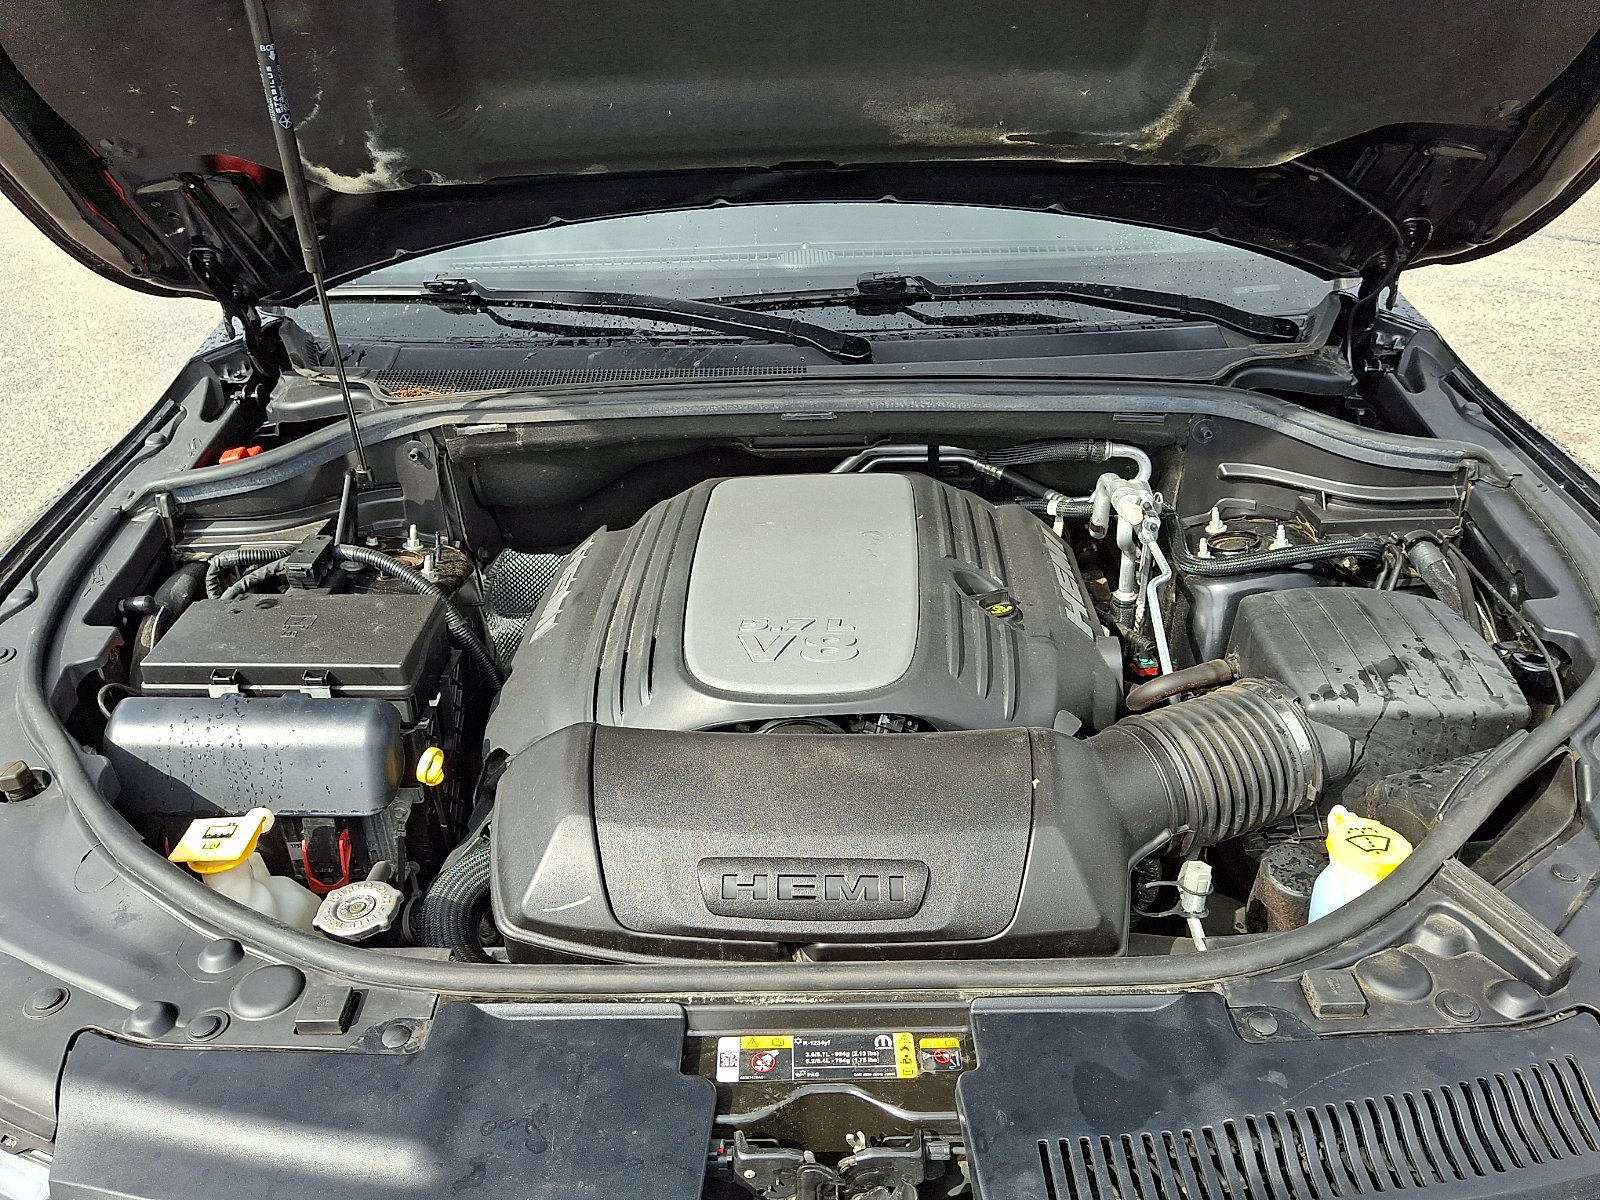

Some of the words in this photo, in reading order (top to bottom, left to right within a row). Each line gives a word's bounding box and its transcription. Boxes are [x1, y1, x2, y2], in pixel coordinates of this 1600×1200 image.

[265, 65, 282, 114] STABILUS
[1040, 524, 1094, 640] HEMI
[738, 617, 857, 632] 5.7L
[737, 633, 860, 663] V8
[721, 873, 905, 902] HEMI
